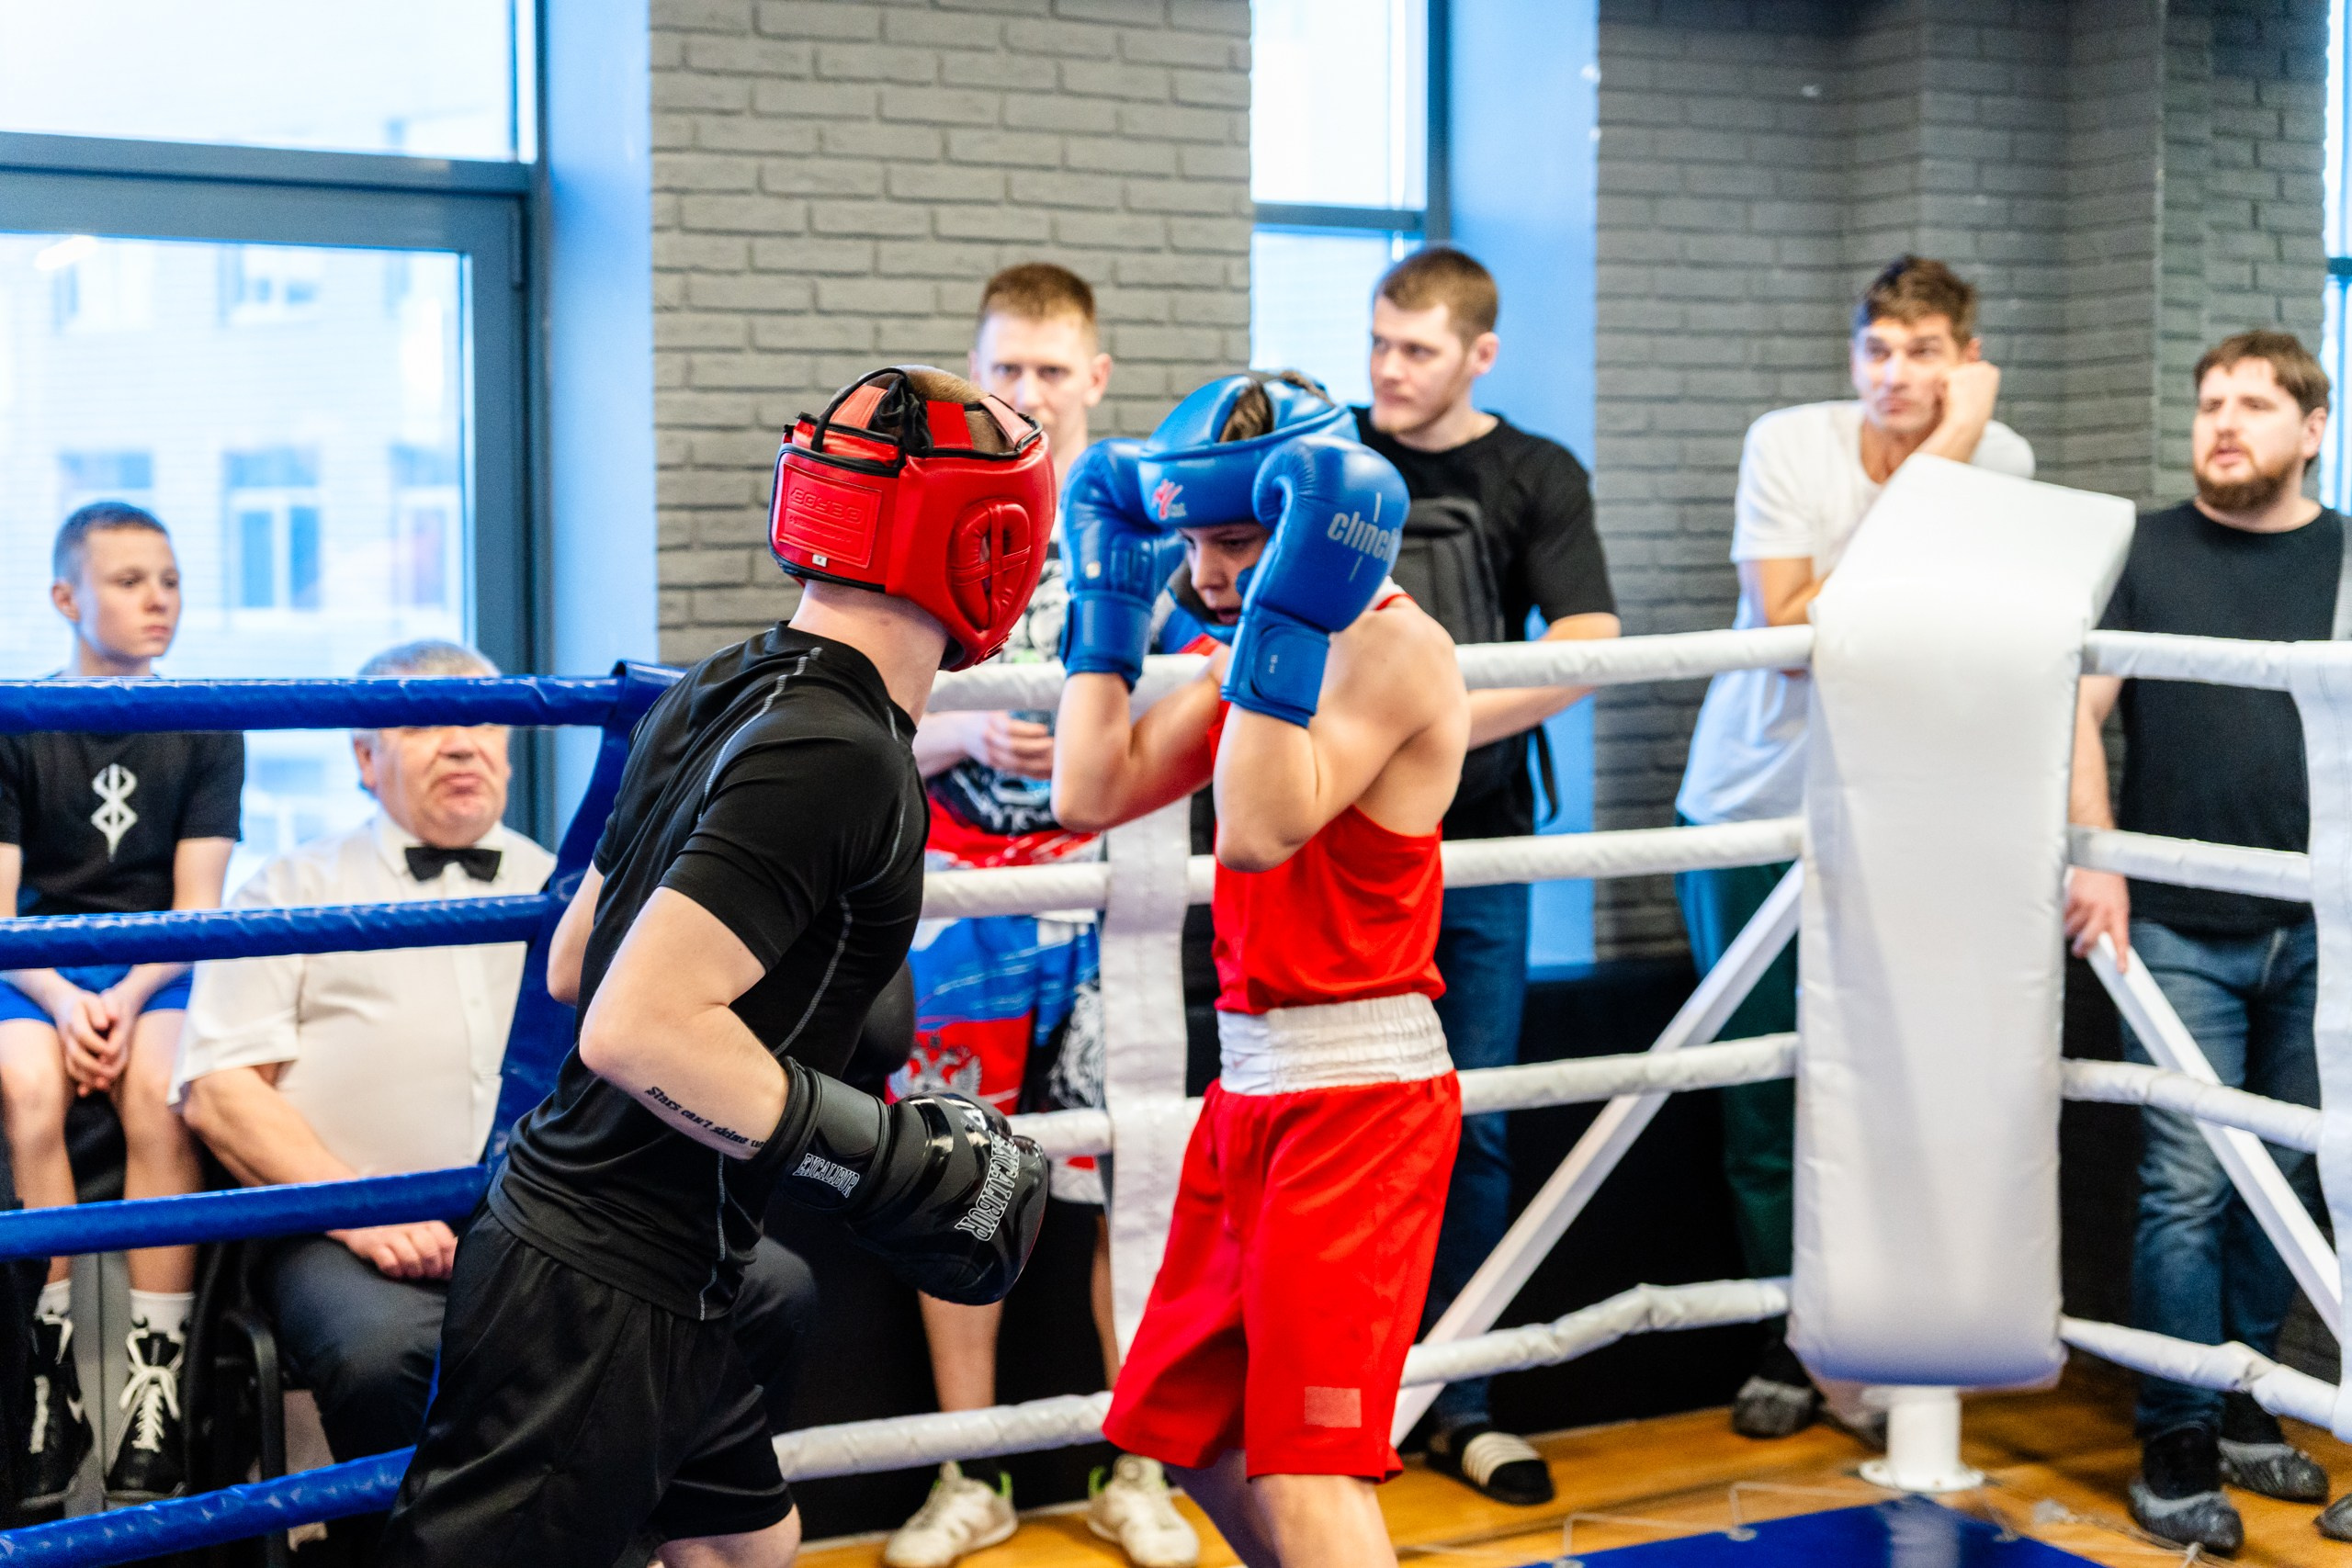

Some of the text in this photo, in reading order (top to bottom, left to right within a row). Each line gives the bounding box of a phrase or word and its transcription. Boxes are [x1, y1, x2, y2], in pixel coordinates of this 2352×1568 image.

[644, 1086, 682, 1111] Stars
[792, 1153, 860, 1198] EXCALIBUR
[955, 1130, 1020, 1241] EXCALIBUR
